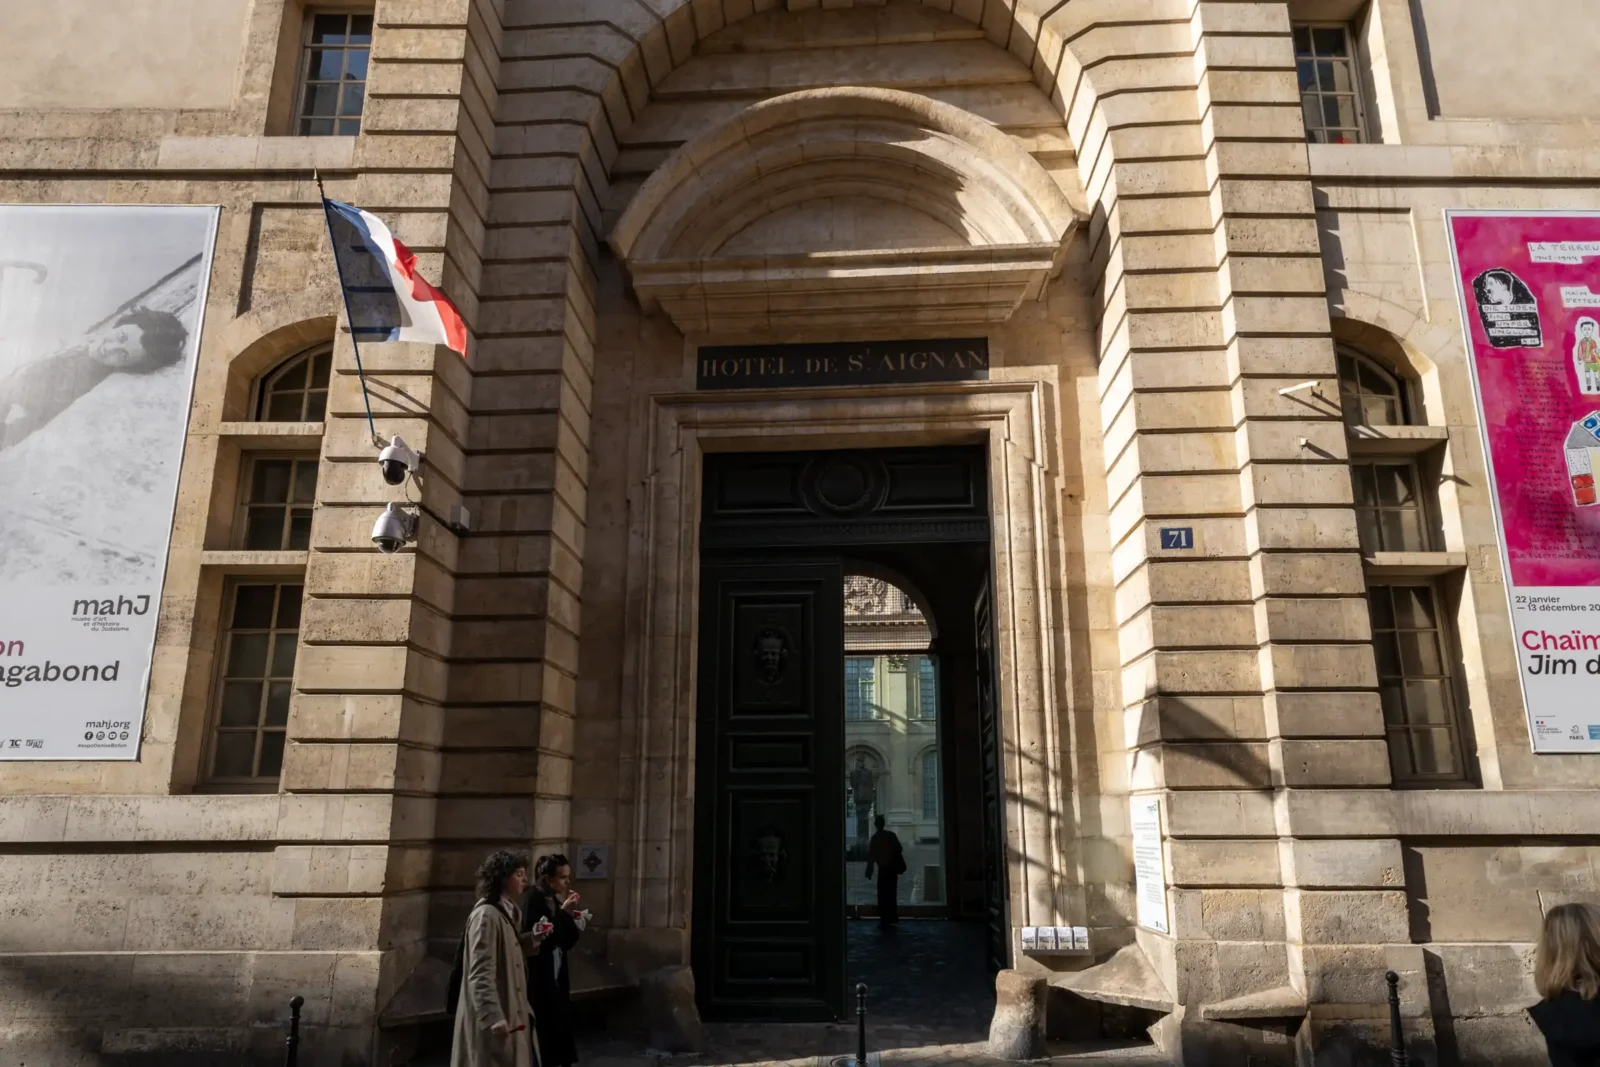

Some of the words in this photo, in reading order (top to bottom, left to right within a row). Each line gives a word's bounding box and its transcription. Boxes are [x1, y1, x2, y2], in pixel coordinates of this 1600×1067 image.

[806, 357, 838, 374] DE
[1168, 530, 1187, 547] 71
[72, 594, 151, 616] mahJ
[1515, 595, 1527, 604] 22
[1527, 595, 1561, 605] janvier
[1527, 604, 1537, 612] 13
[1539, 603, 1587, 612] décembre
[1527, 654, 1577, 675] Jim
[85, 719, 131, 730] mahj.org
